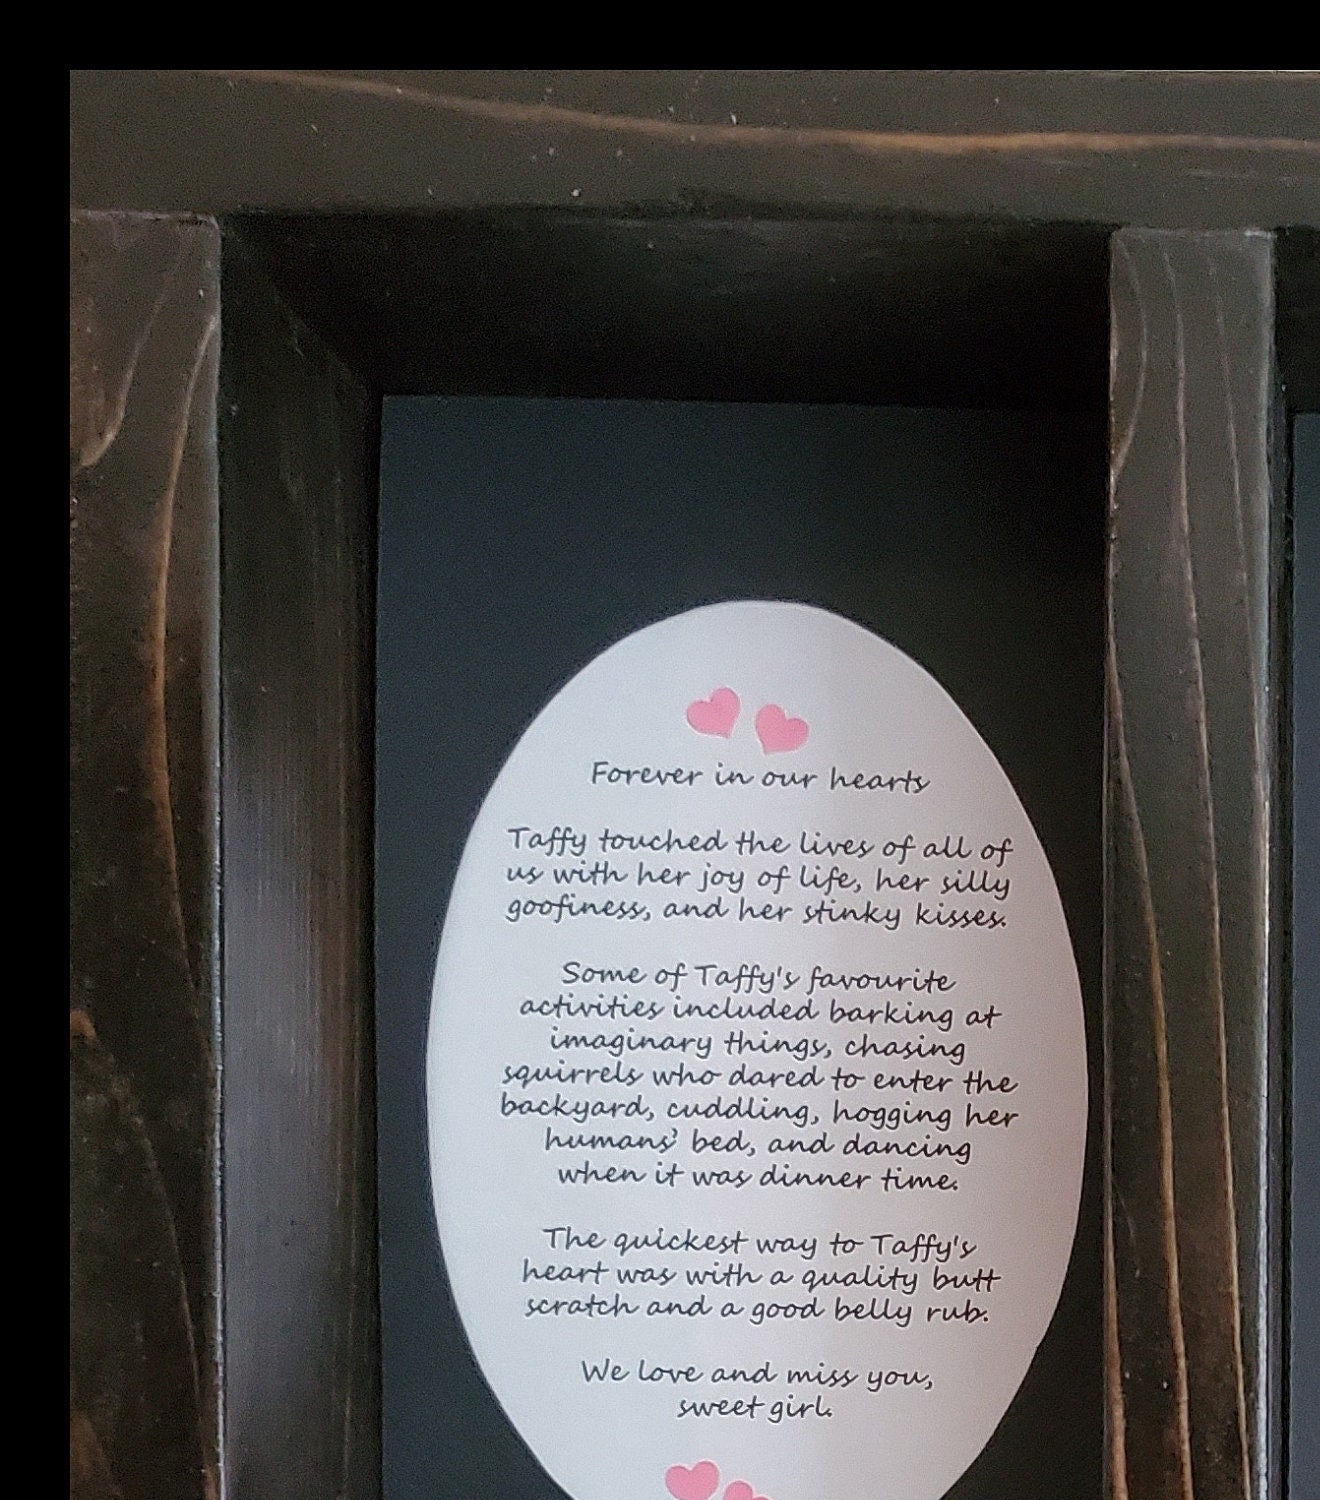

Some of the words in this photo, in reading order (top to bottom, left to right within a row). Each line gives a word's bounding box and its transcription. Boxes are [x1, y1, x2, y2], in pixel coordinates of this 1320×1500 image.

[592, 761, 703, 786] Forever
[716, 762, 754, 785] in
[762, 771, 818, 788] our
[831, 767, 930, 793] hearts
[508, 826, 586, 856] Taffy
[599, 829, 728, 853] touched
[735, 831, 791, 855] the
[800, 832, 875, 858] lives
[883, 835, 916, 865] of
[923, 836, 972, 858] all
[981, 838, 1013, 868] of
[507, 867, 544, 884] us
[553, 860, 628, 885] with
[638, 862, 691, 886] her
[697, 863, 744, 893] joy
[758, 865, 791, 894] of
[800, 865, 861, 896] life,
[876, 868, 929, 892] her
[941, 870, 1009, 900] silly
[506, 894, 650, 923] goofiness,
[663, 896, 729, 918] and
[739, 897, 792, 922] her
[803, 899, 900, 930] stinky
[916, 902, 1006, 929] kisses.
[562, 962, 647, 984] Some
[655, 963, 688, 992] of
[694, 964, 800, 994] Taffy's
[806, 966, 956, 995] favourite
[520, 993, 665, 1020] activities
[674, 995, 819, 1021] included
[830, 999, 952, 1032] barking
[966, 1005, 1002, 1029] at
[551, 1026, 712, 1059] imaginary
[724, 1030, 831, 1061] things,
[845, 1034, 965, 1065] chasing
[502, 1060, 644, 1089] squirrels
[653, 1063, 722, 1087] who
[729, 1063, 825, 1088] dared
[831, 1067, 865, 1091] to
[874, 1069, 953, 1093] enter
[963, 1070, 1018, 1094] the
[501, 1092, 654, 1123] backyard,
[667, 1096, 819, 1128] cuddling,
[833, 1099, 951, 1131] hogging
[966, 1103, 1019, 1127] her
[692, 1128, 755, 1157] bed,
[768, 1132, 835, 1154] and
[843, 1132, 970, 1165] dancing
[558, 1161, 647, 1184] when
[656, 1162, 684, 1187] it
[693, 1170, 753, 1188] was
[760, 1164, 871, 1189] dinner
[881, 1167, 958, 1192] time.
[542, 1226, 606, 1250] The
[614, 1228, 749, 1256] quickest
[756, 1238, 817, 1260] way
[829, 1233, 864, 1256] to
[870, 1234, 976, 1262] Taffy's
[523, 1259, 609, 1284] heart
[617, 1268, 677, 1286] was
[686, 1262, 763, 1287] with
[770, 1271, 794, 1285] a
[802, 1265, 917, 1295] quality
[933, 1266, 1001, 1292] butt
[525, 1293, 640, 1317] scratch
[647, 1295, 713, 1316] and
[721, 1303, 744, 1317] a
[750, 1297, 825, 1325] good
[835, 1297, 911, 1327] belly
[927, 1299, 988, 1323] rub.
[582, 1358, 630, 1382] We
[639, 1360, 704, 1383] love
[711, 1362, 778, 1383] and
[788, 1363, 858, 1387] miss
[867, 1371, 932, 1392] you,
[677, 1395, 765, 1419] sweet
[768, 1394, 832, 1423] girl.
